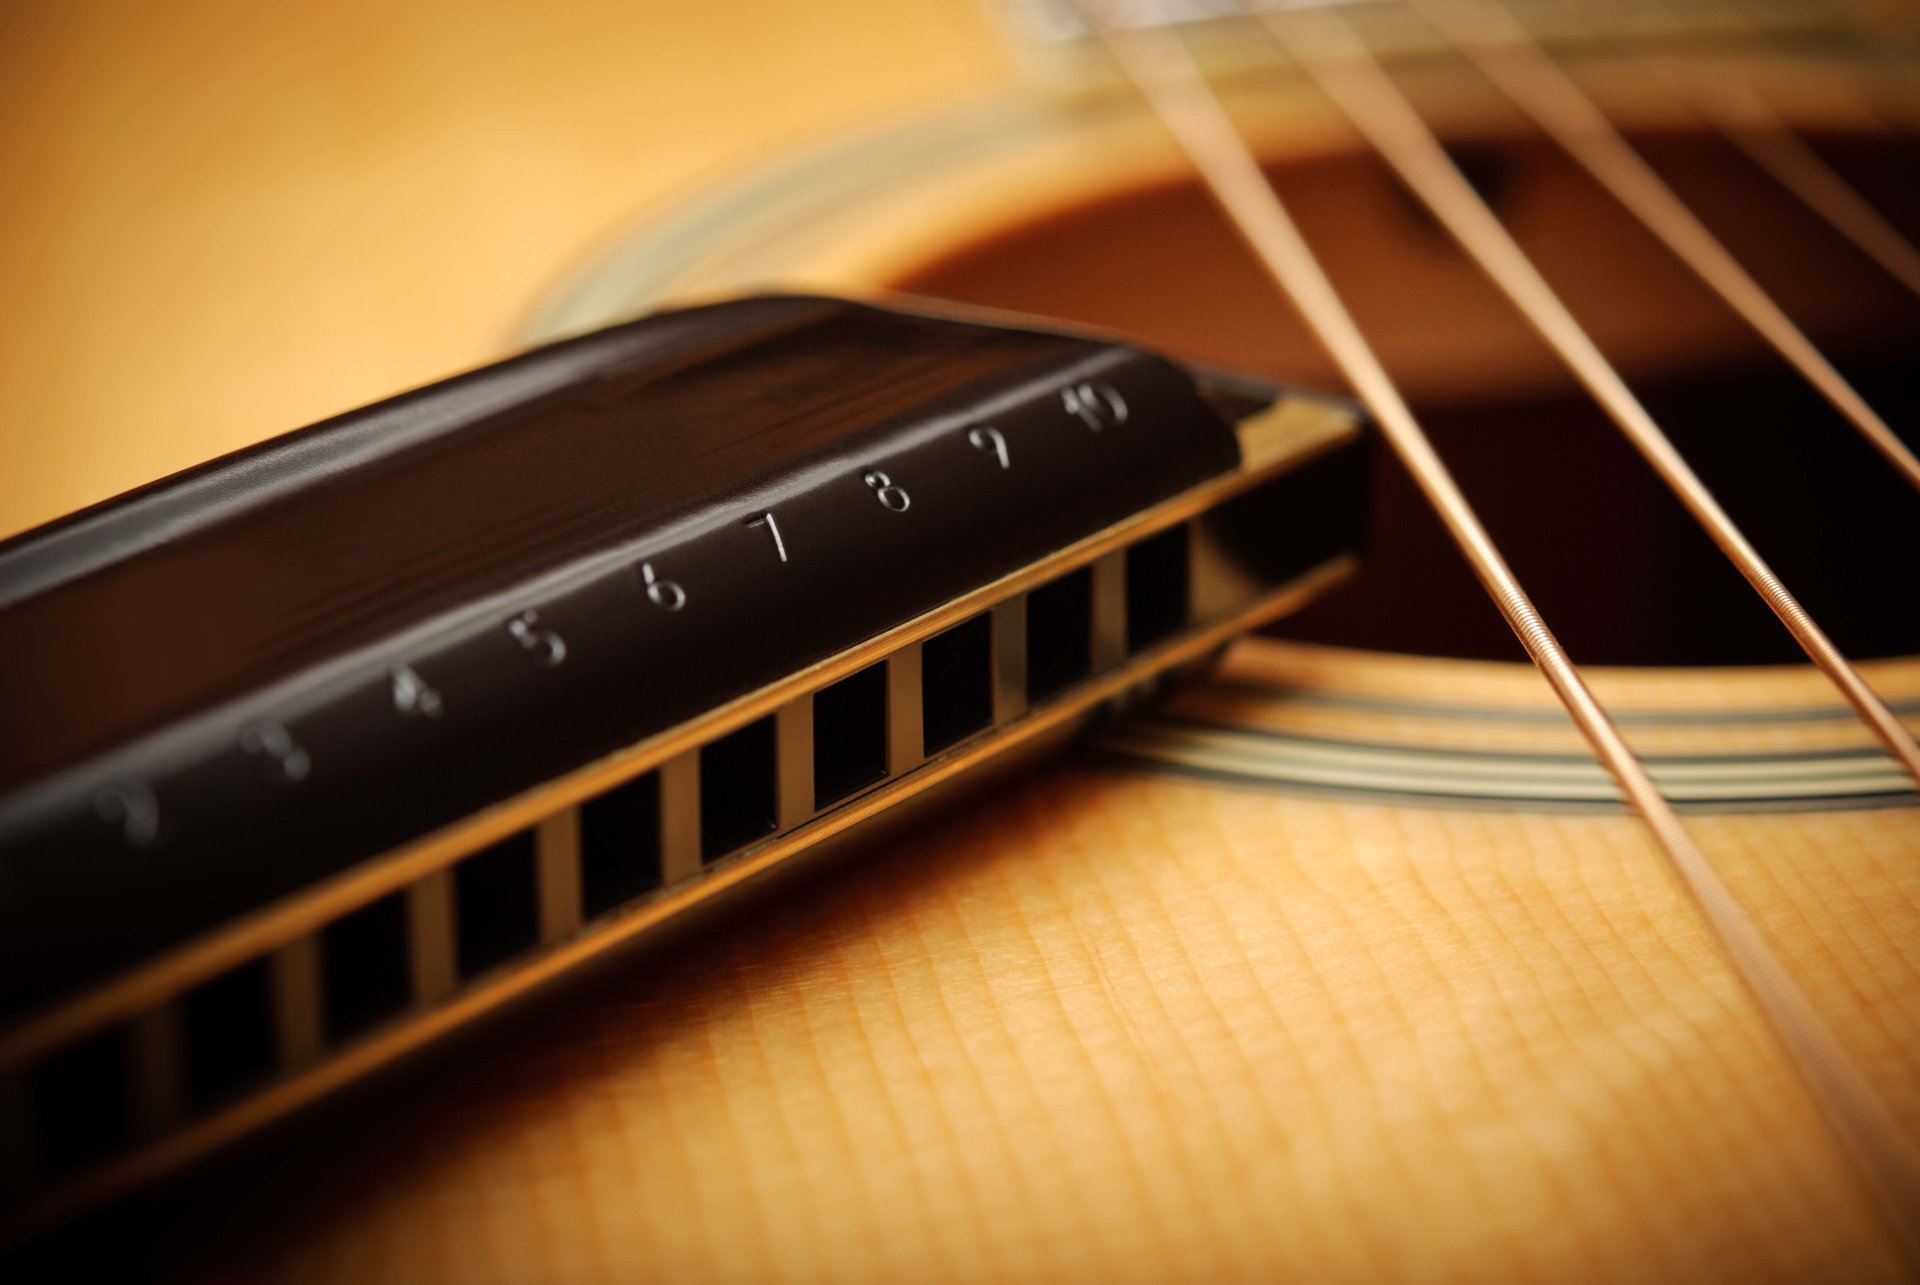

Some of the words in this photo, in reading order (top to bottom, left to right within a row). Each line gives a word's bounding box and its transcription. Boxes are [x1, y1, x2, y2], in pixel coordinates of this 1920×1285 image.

[509, 608, 567, 666] 5
[642, 562, 686, 611] 6
[744, 512, 788, 562] 7
[864, 470, 911, 512] 8
[968, 426, 1010, 470] 9
[1060, 382, 1129, 433] 10
